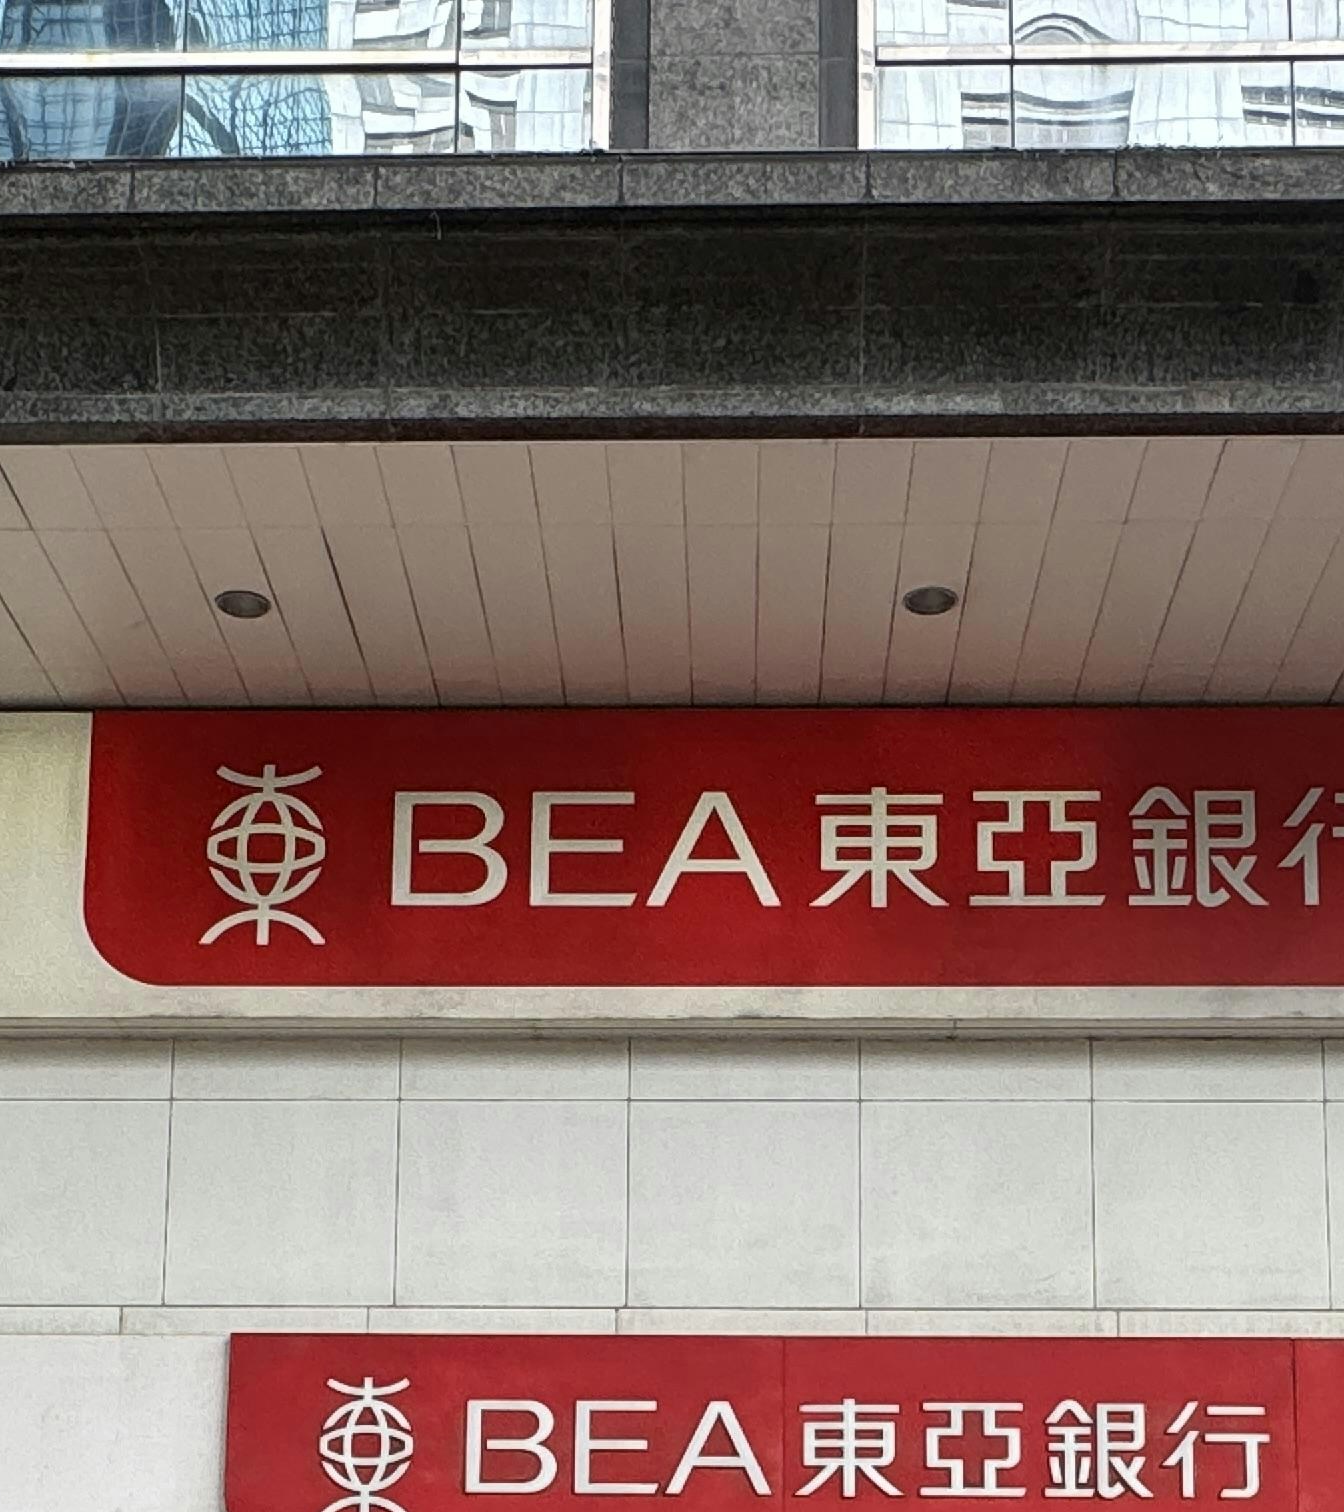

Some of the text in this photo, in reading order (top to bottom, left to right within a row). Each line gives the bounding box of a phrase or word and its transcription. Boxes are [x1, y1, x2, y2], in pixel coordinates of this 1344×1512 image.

[391, 789, 781, 907] BEA
[464, 1397, 1271, 1501] BEA 東亞銀行
